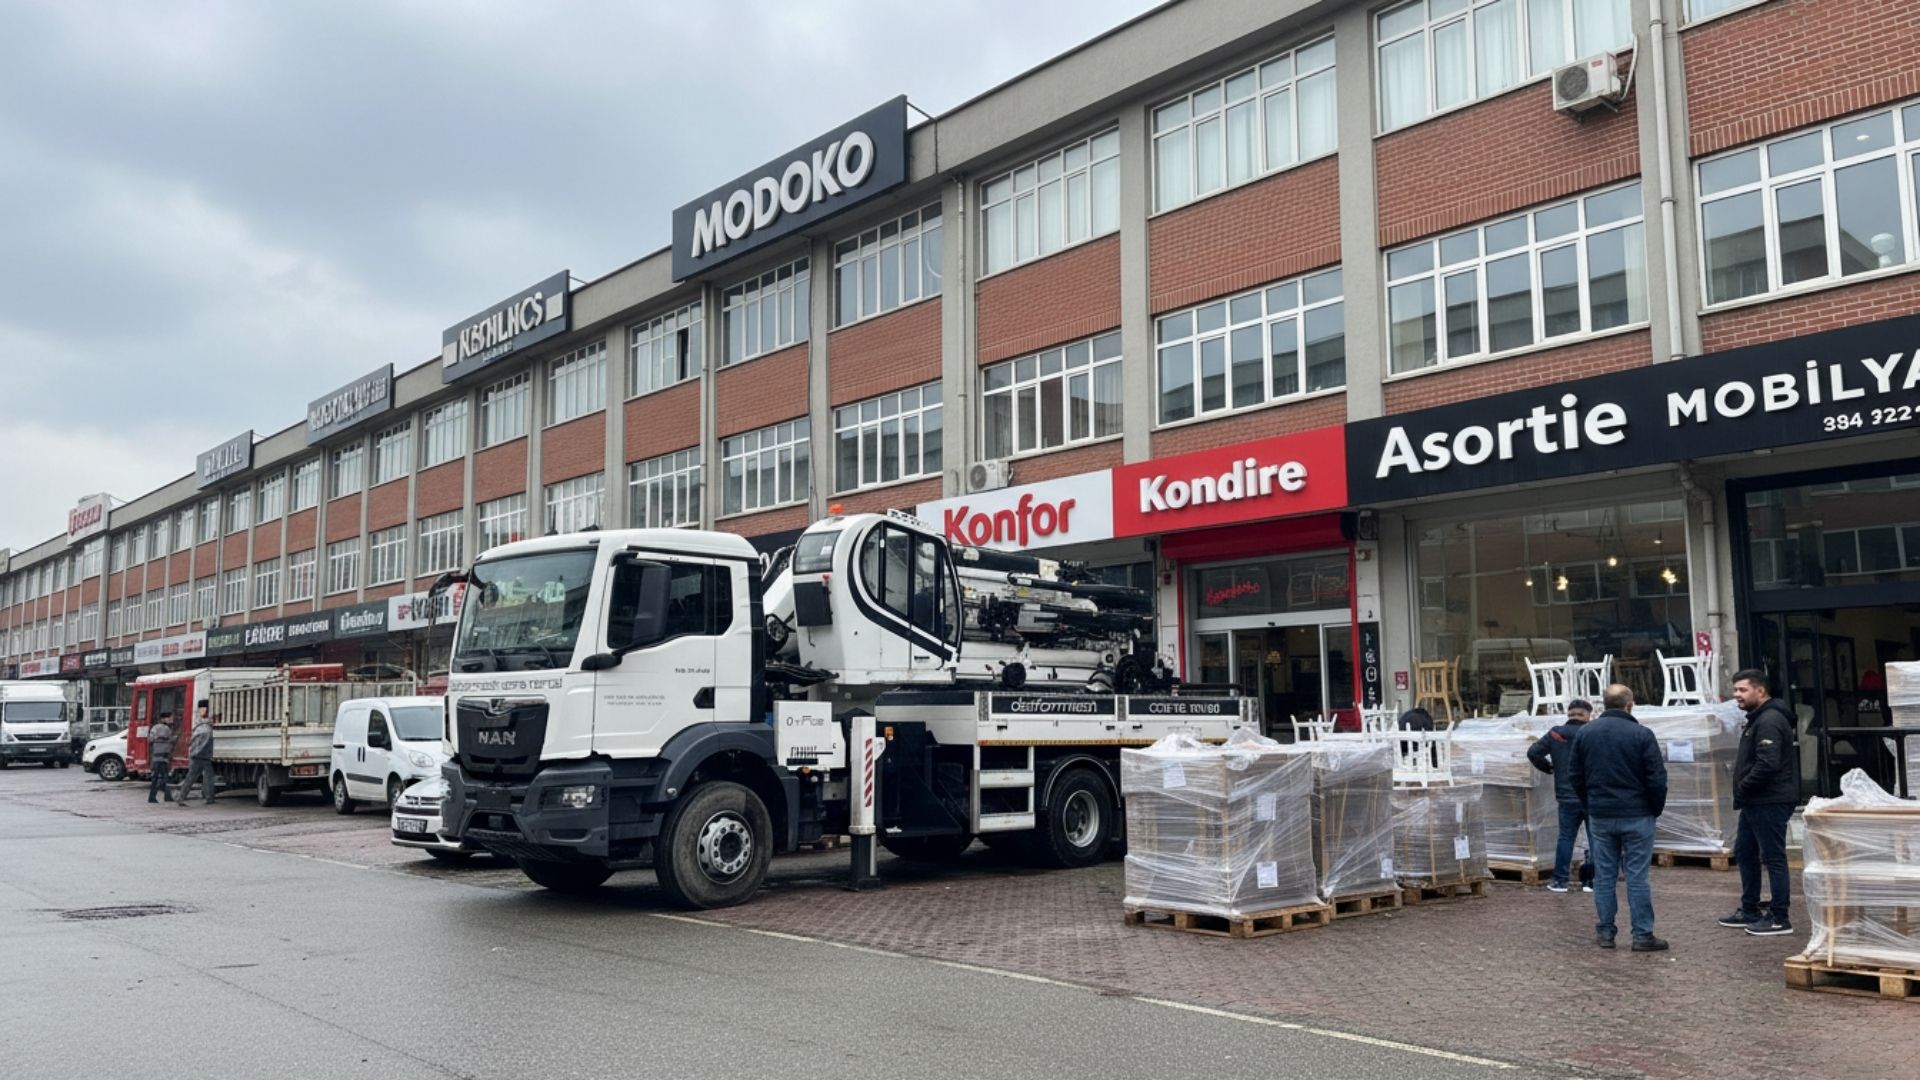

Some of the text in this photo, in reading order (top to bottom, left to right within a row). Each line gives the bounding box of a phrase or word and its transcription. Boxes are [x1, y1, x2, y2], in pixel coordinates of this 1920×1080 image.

[691, 131, 874, 259] MODOKO
[1375, 393, 1628, 479] Asortie
[944, 494, 1076, 546] Konfor
[1139, 458, 1308, 513] Kondire
